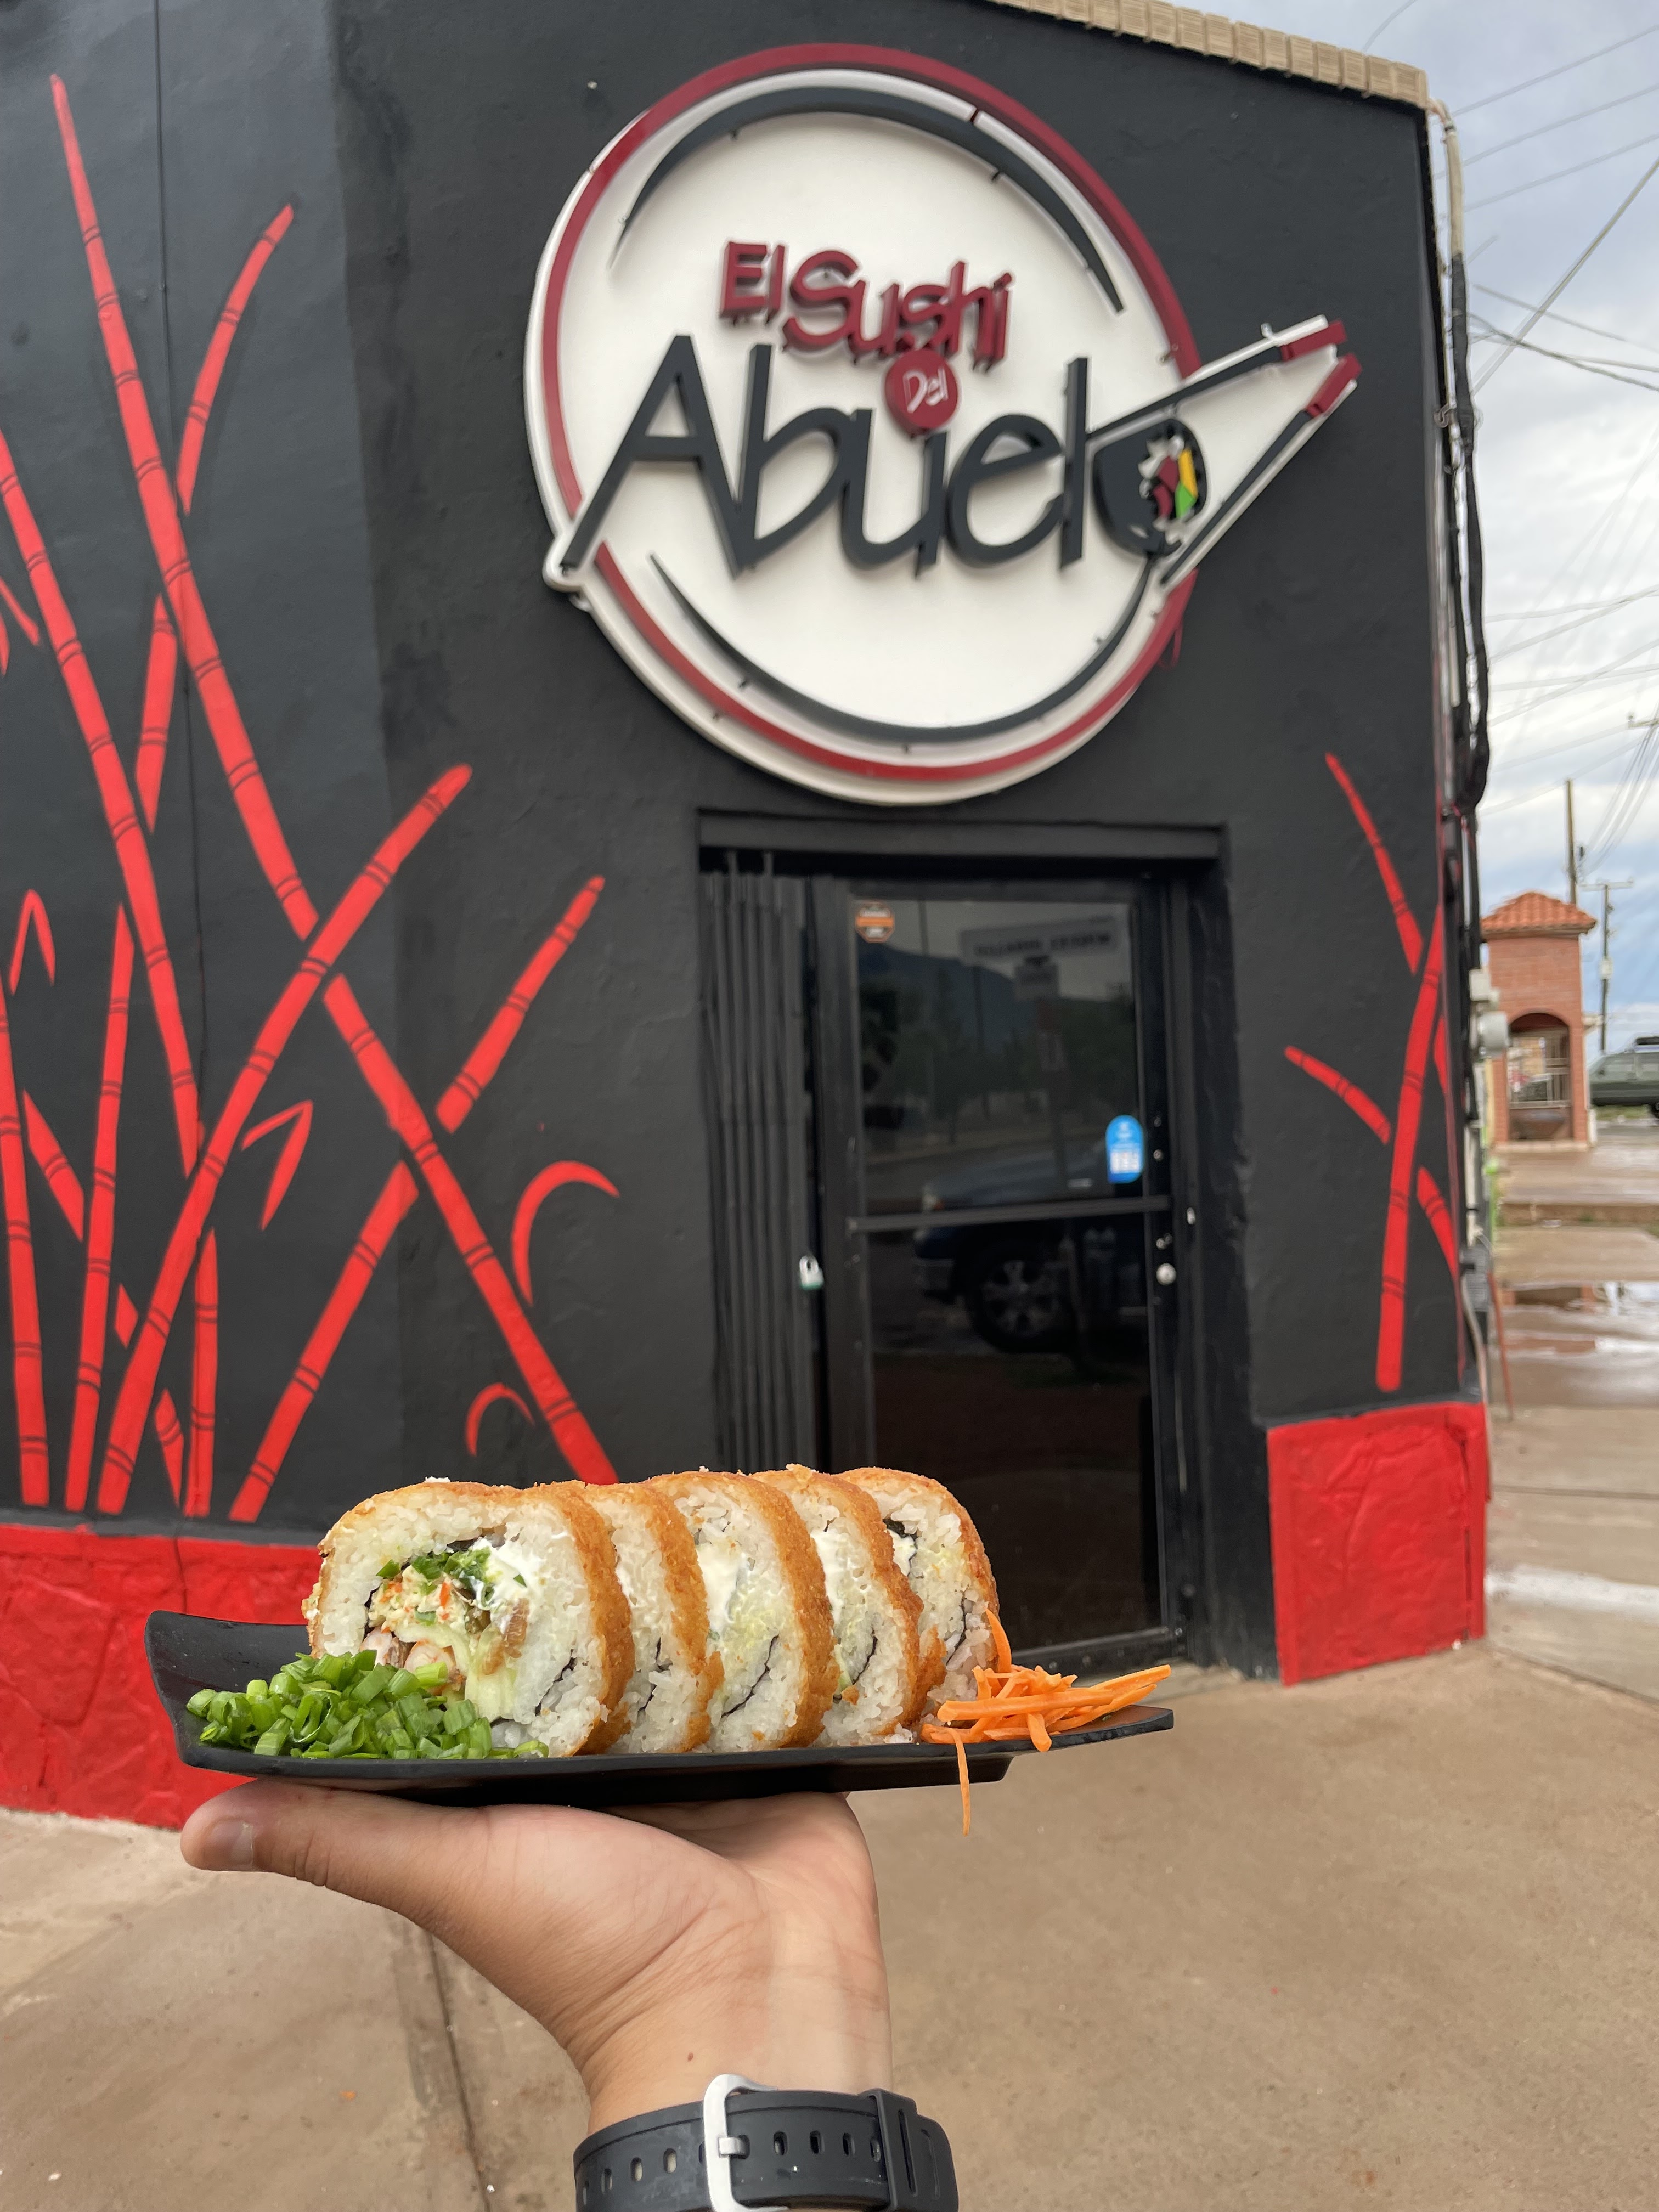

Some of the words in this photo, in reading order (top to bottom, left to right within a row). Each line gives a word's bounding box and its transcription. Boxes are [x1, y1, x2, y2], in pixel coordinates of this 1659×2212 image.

[719, 241, 786, 323] El
[782, 248, 1013, 368] Sushi
[902, 368, 949, 414] Del
[558, 335, 1209, 583] Abuelo
